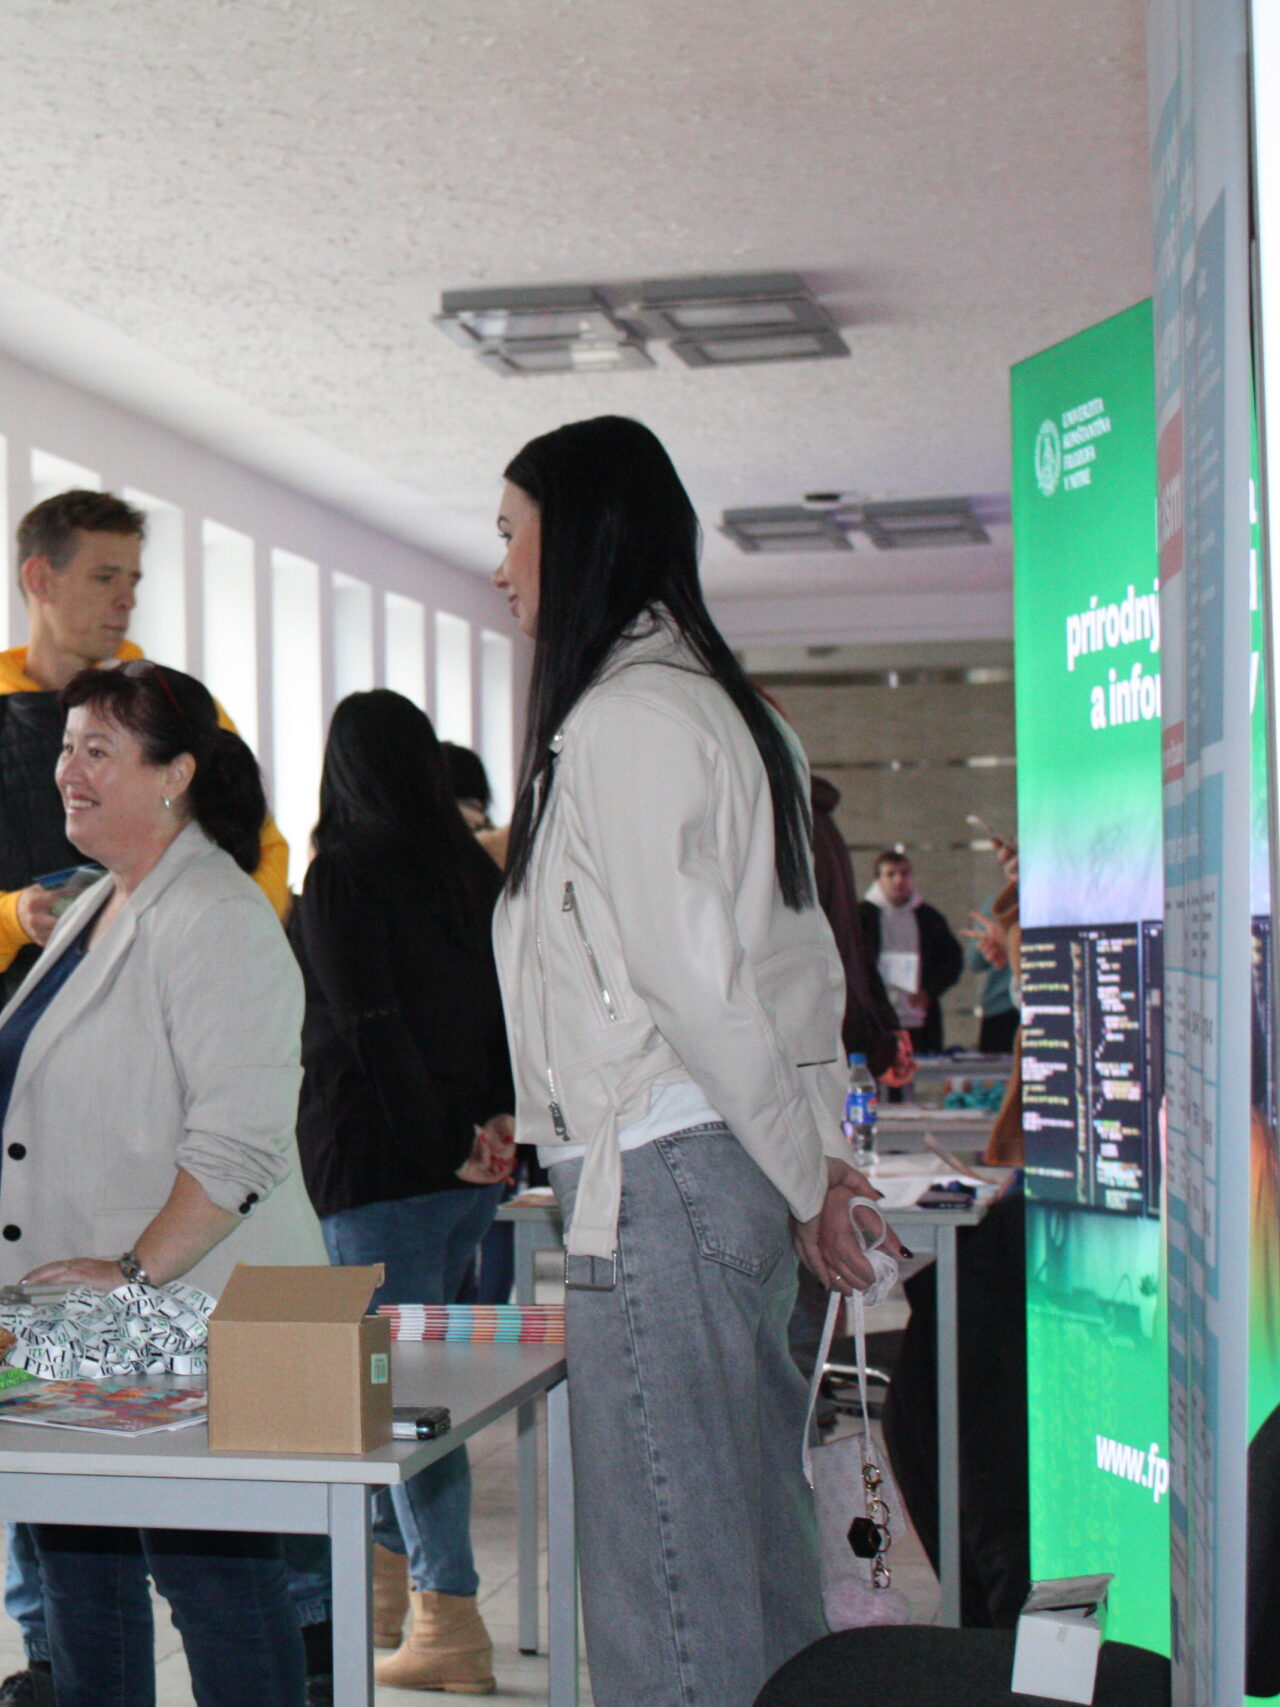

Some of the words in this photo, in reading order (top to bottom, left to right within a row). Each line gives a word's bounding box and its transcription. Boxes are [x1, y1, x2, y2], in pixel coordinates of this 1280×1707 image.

[1066, 577, 1160, 672] prírodný
[1090, 685, 1107, 730] a
[1096, 1434, 1169, 1503] www.fp
